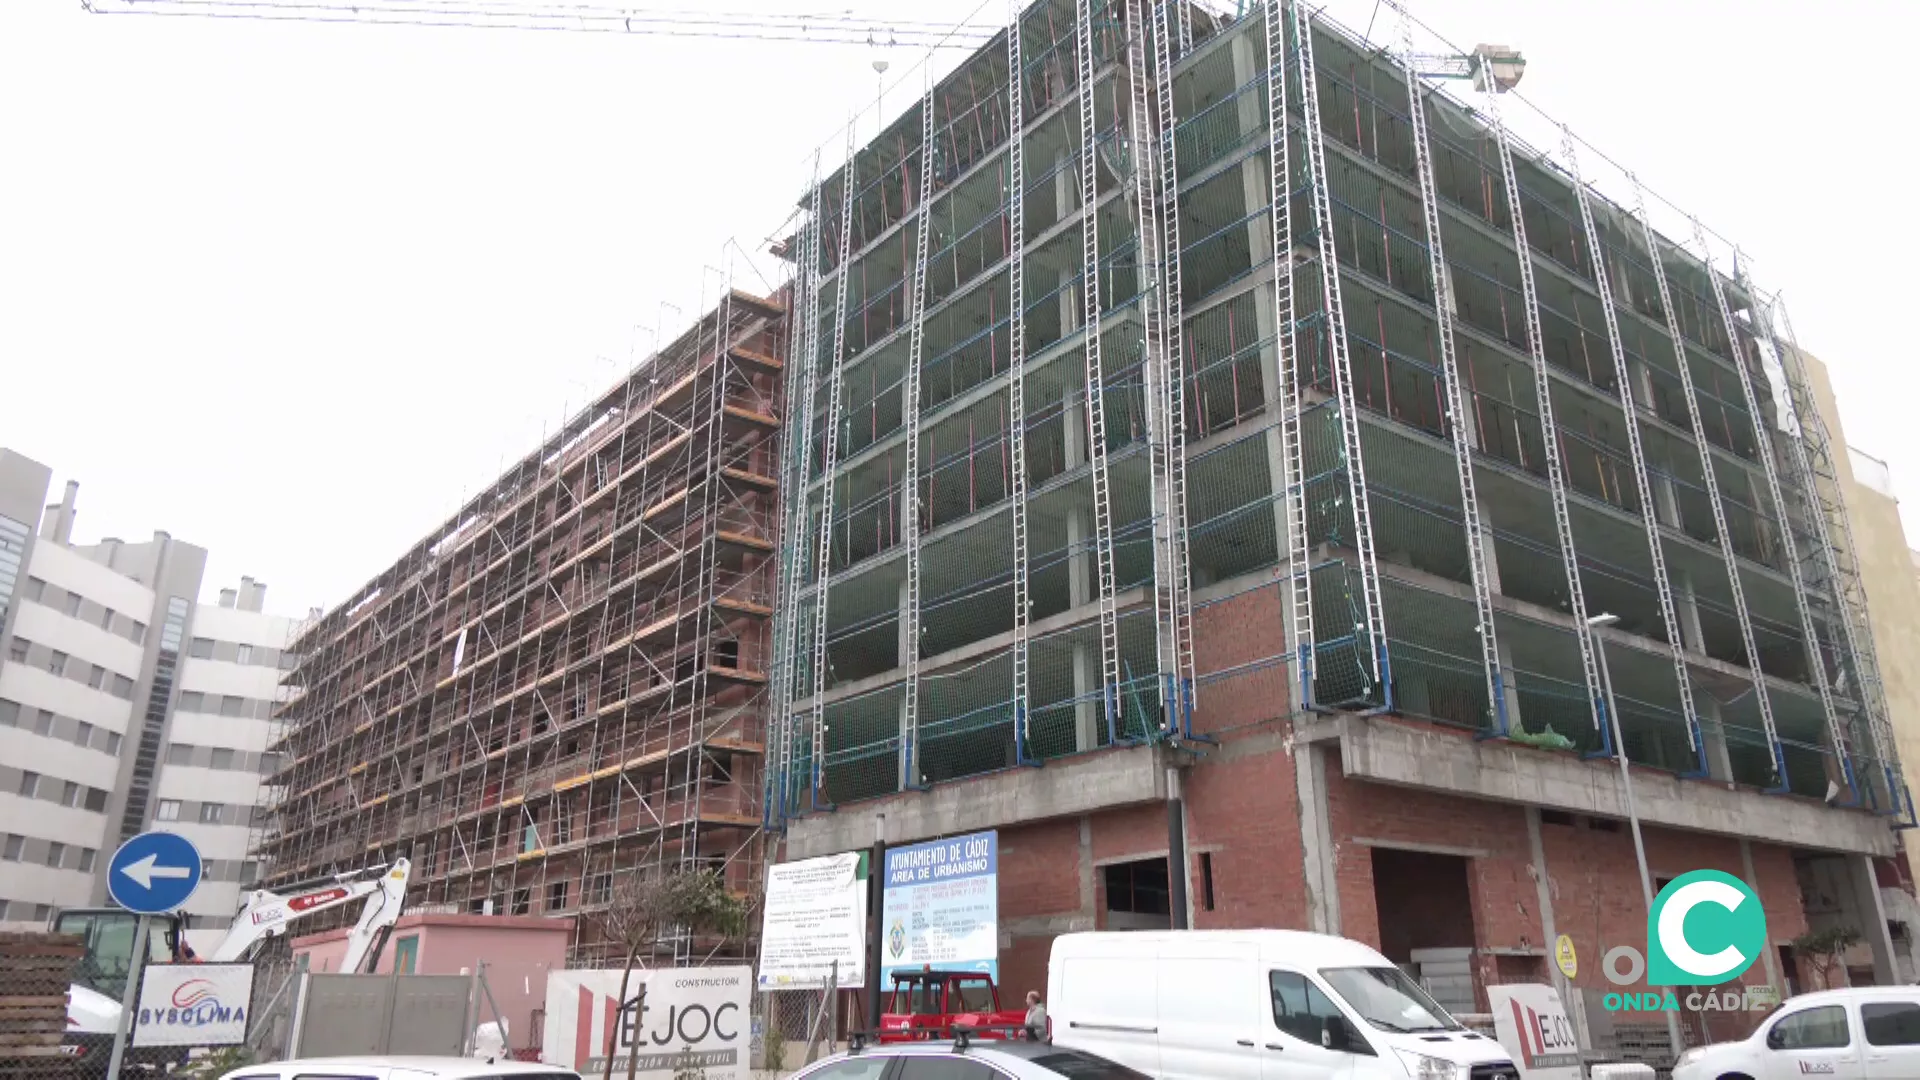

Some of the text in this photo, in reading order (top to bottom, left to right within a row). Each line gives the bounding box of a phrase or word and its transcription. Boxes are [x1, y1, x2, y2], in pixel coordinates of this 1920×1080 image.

[890, 836, 989, 871] AYUNTAMIENTO DE CÁDIZ
[918, 867, 930, 880] DE
[934, 859, 988, 877] URBANISMO
[675, 977, 740, 988] CONSTRUCTORA
[621, 1001, 739, 1047] EJOC
[592, 1057, 663, 1072] EDFICCIÓN
[706, 1052, 731, 1065] CIVIL
